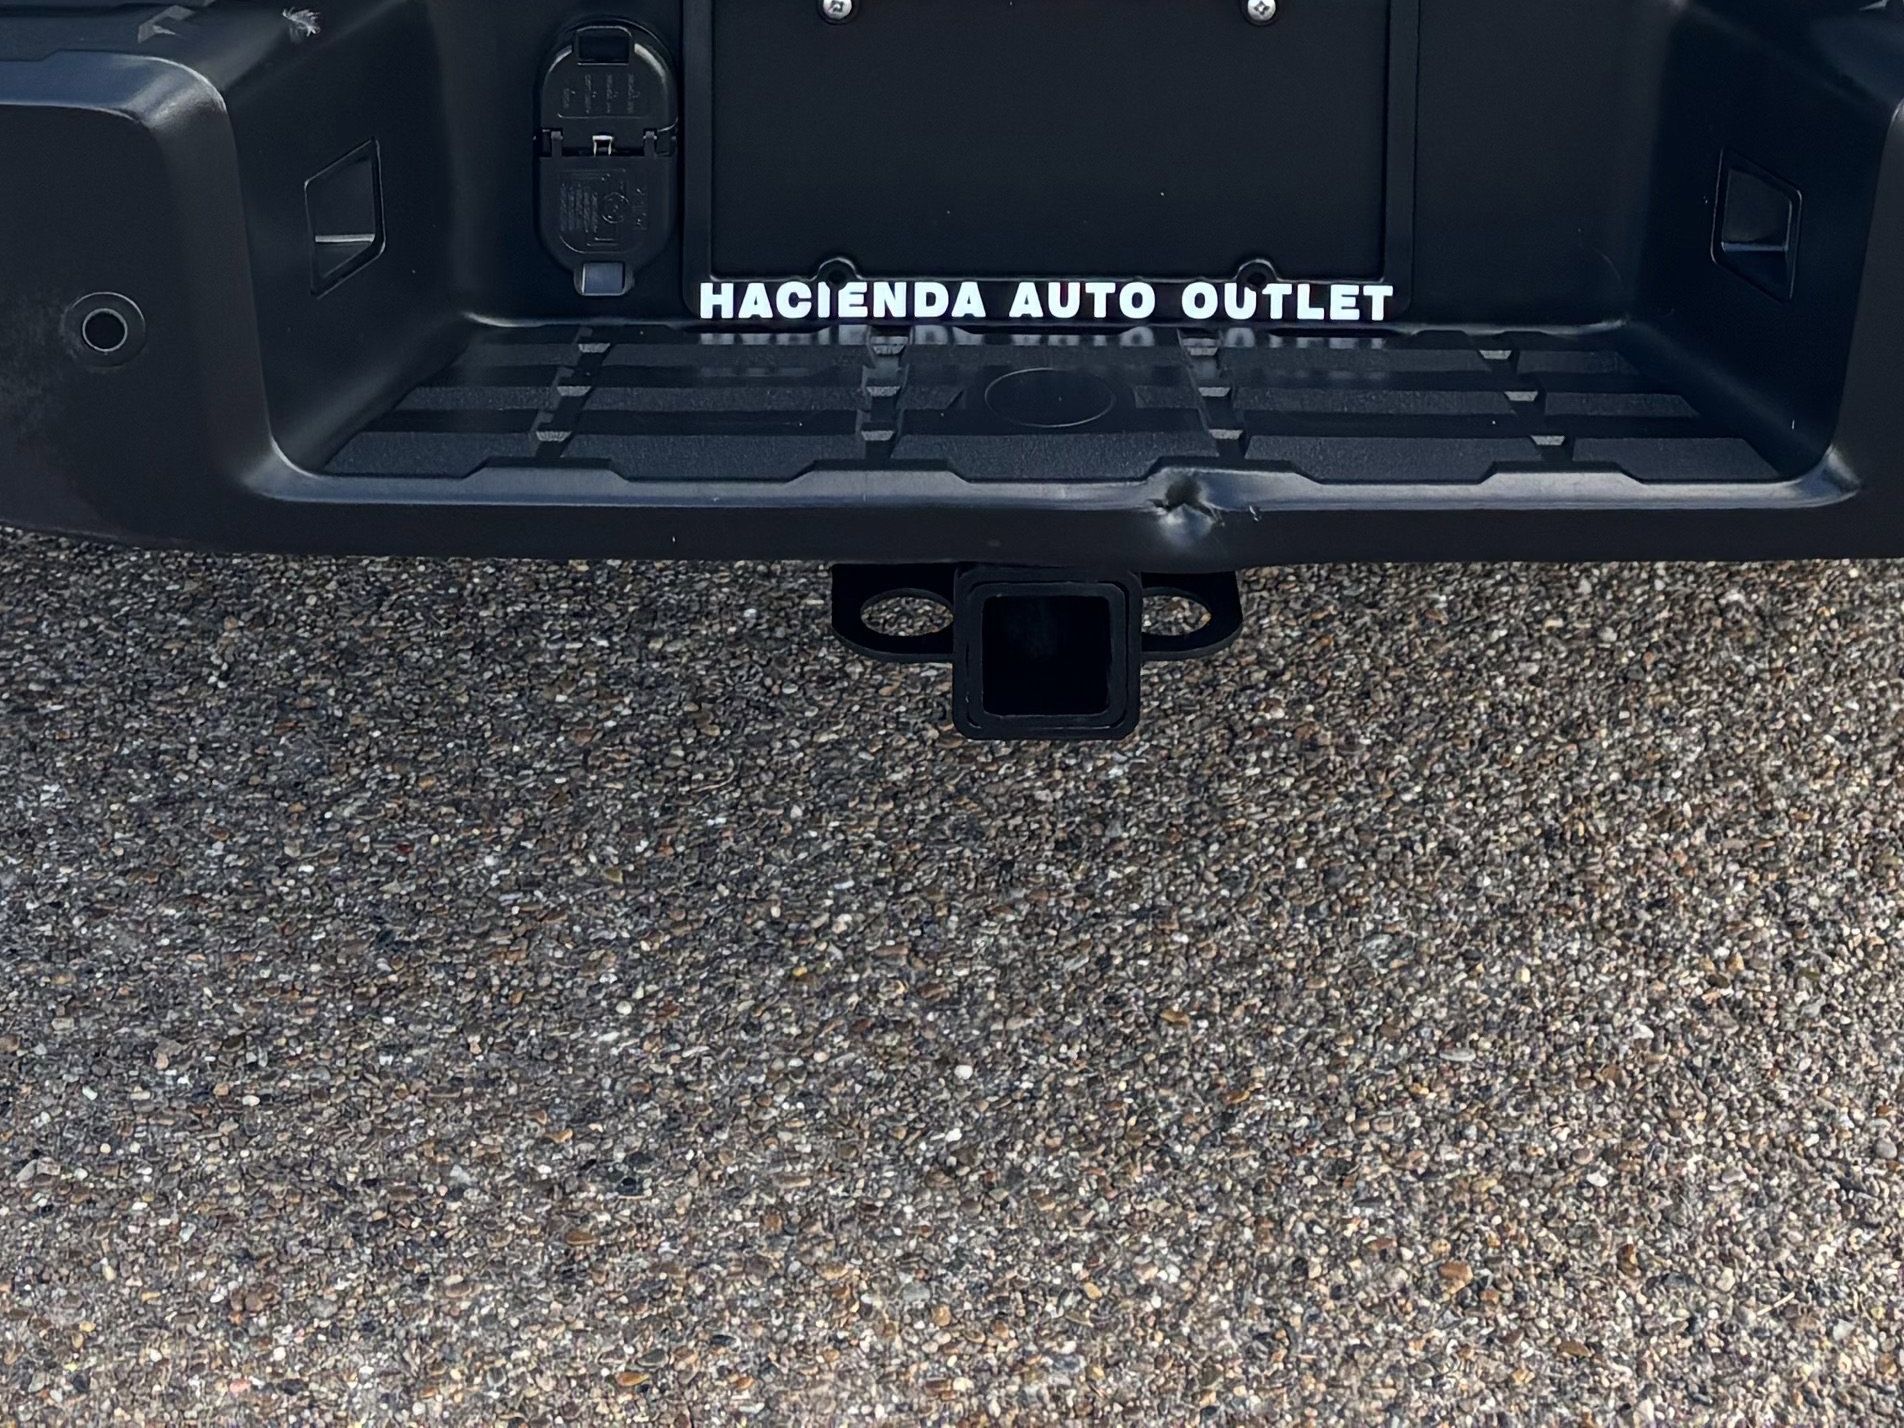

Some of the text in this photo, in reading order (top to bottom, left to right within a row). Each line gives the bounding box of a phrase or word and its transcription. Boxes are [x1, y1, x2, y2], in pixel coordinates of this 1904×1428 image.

[699, 281, 1394, 321] HACIENDA AUTO OUTLET
